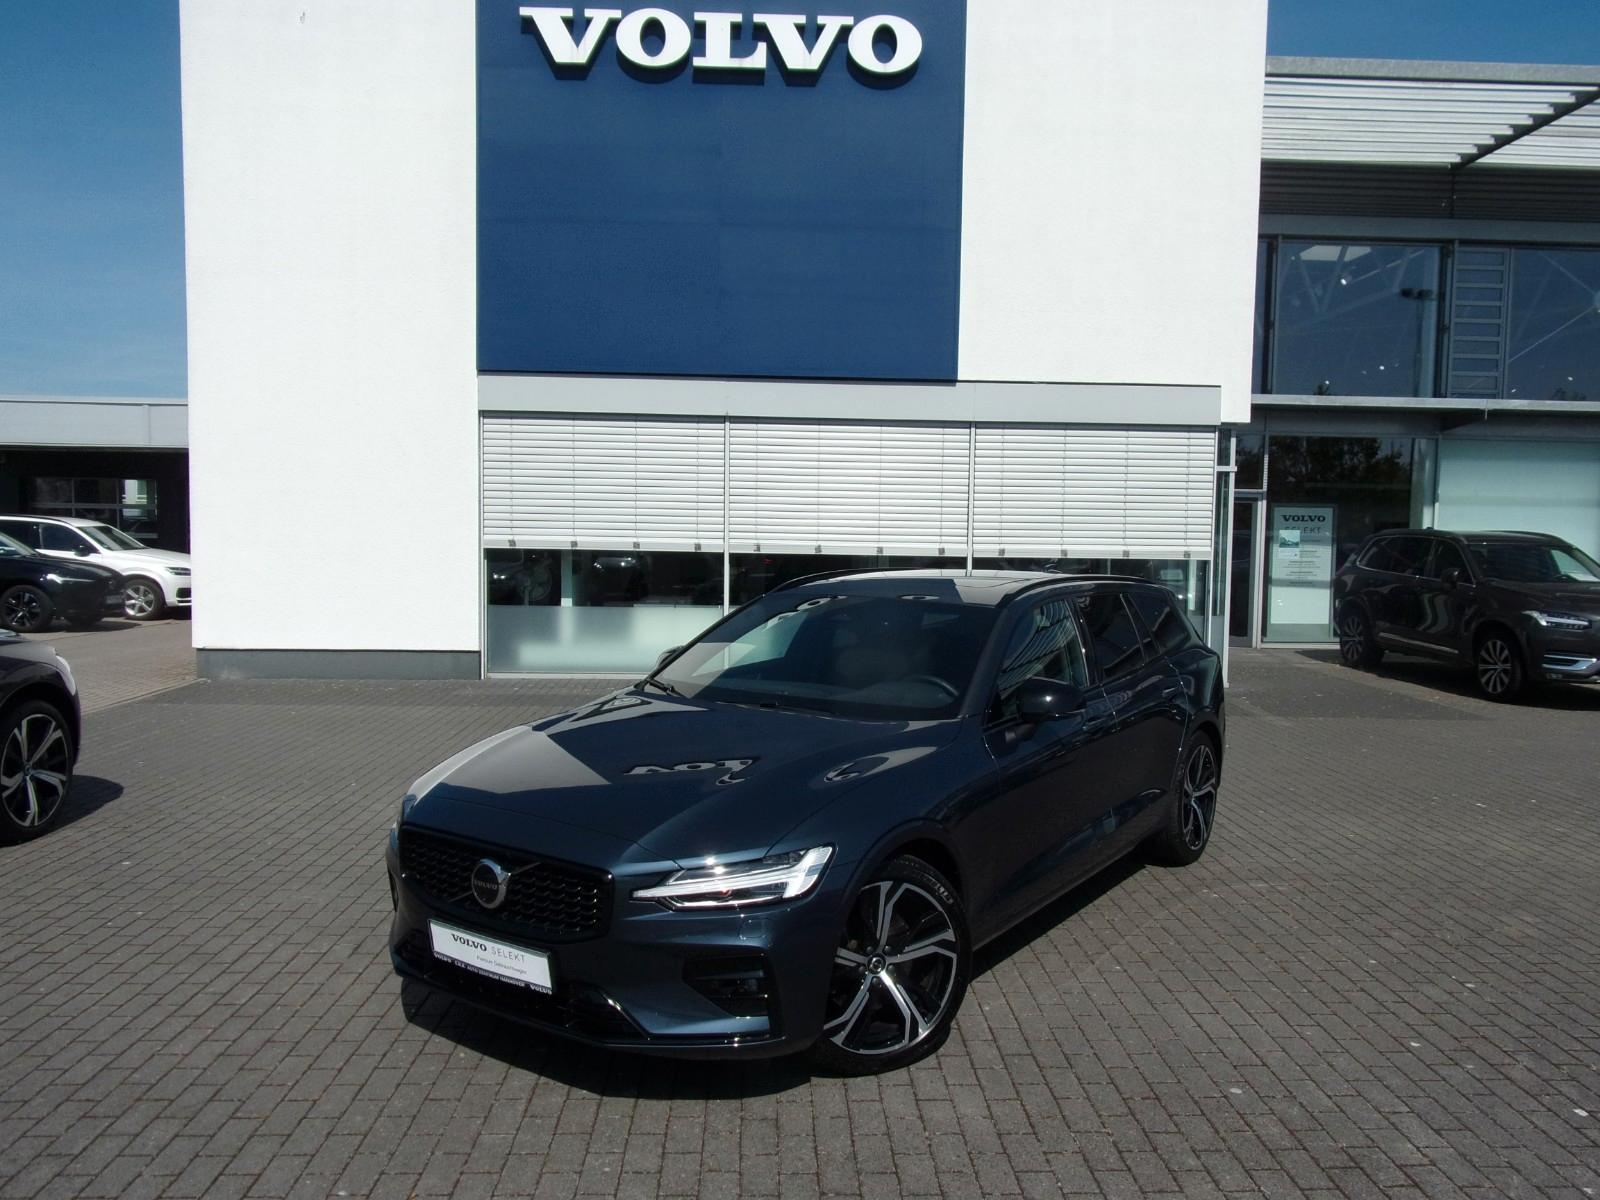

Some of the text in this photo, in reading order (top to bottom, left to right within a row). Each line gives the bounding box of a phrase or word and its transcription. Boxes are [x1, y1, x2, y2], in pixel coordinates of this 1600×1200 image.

[519, 6, 923, 75] VOLVO
[1280, 514, 1326, 523] VOLVO
[1284, 526, 1321, 535] EKT
[451, 933, 487, 952] VOLVO
[491, 946, 525, 963] SELEKT
